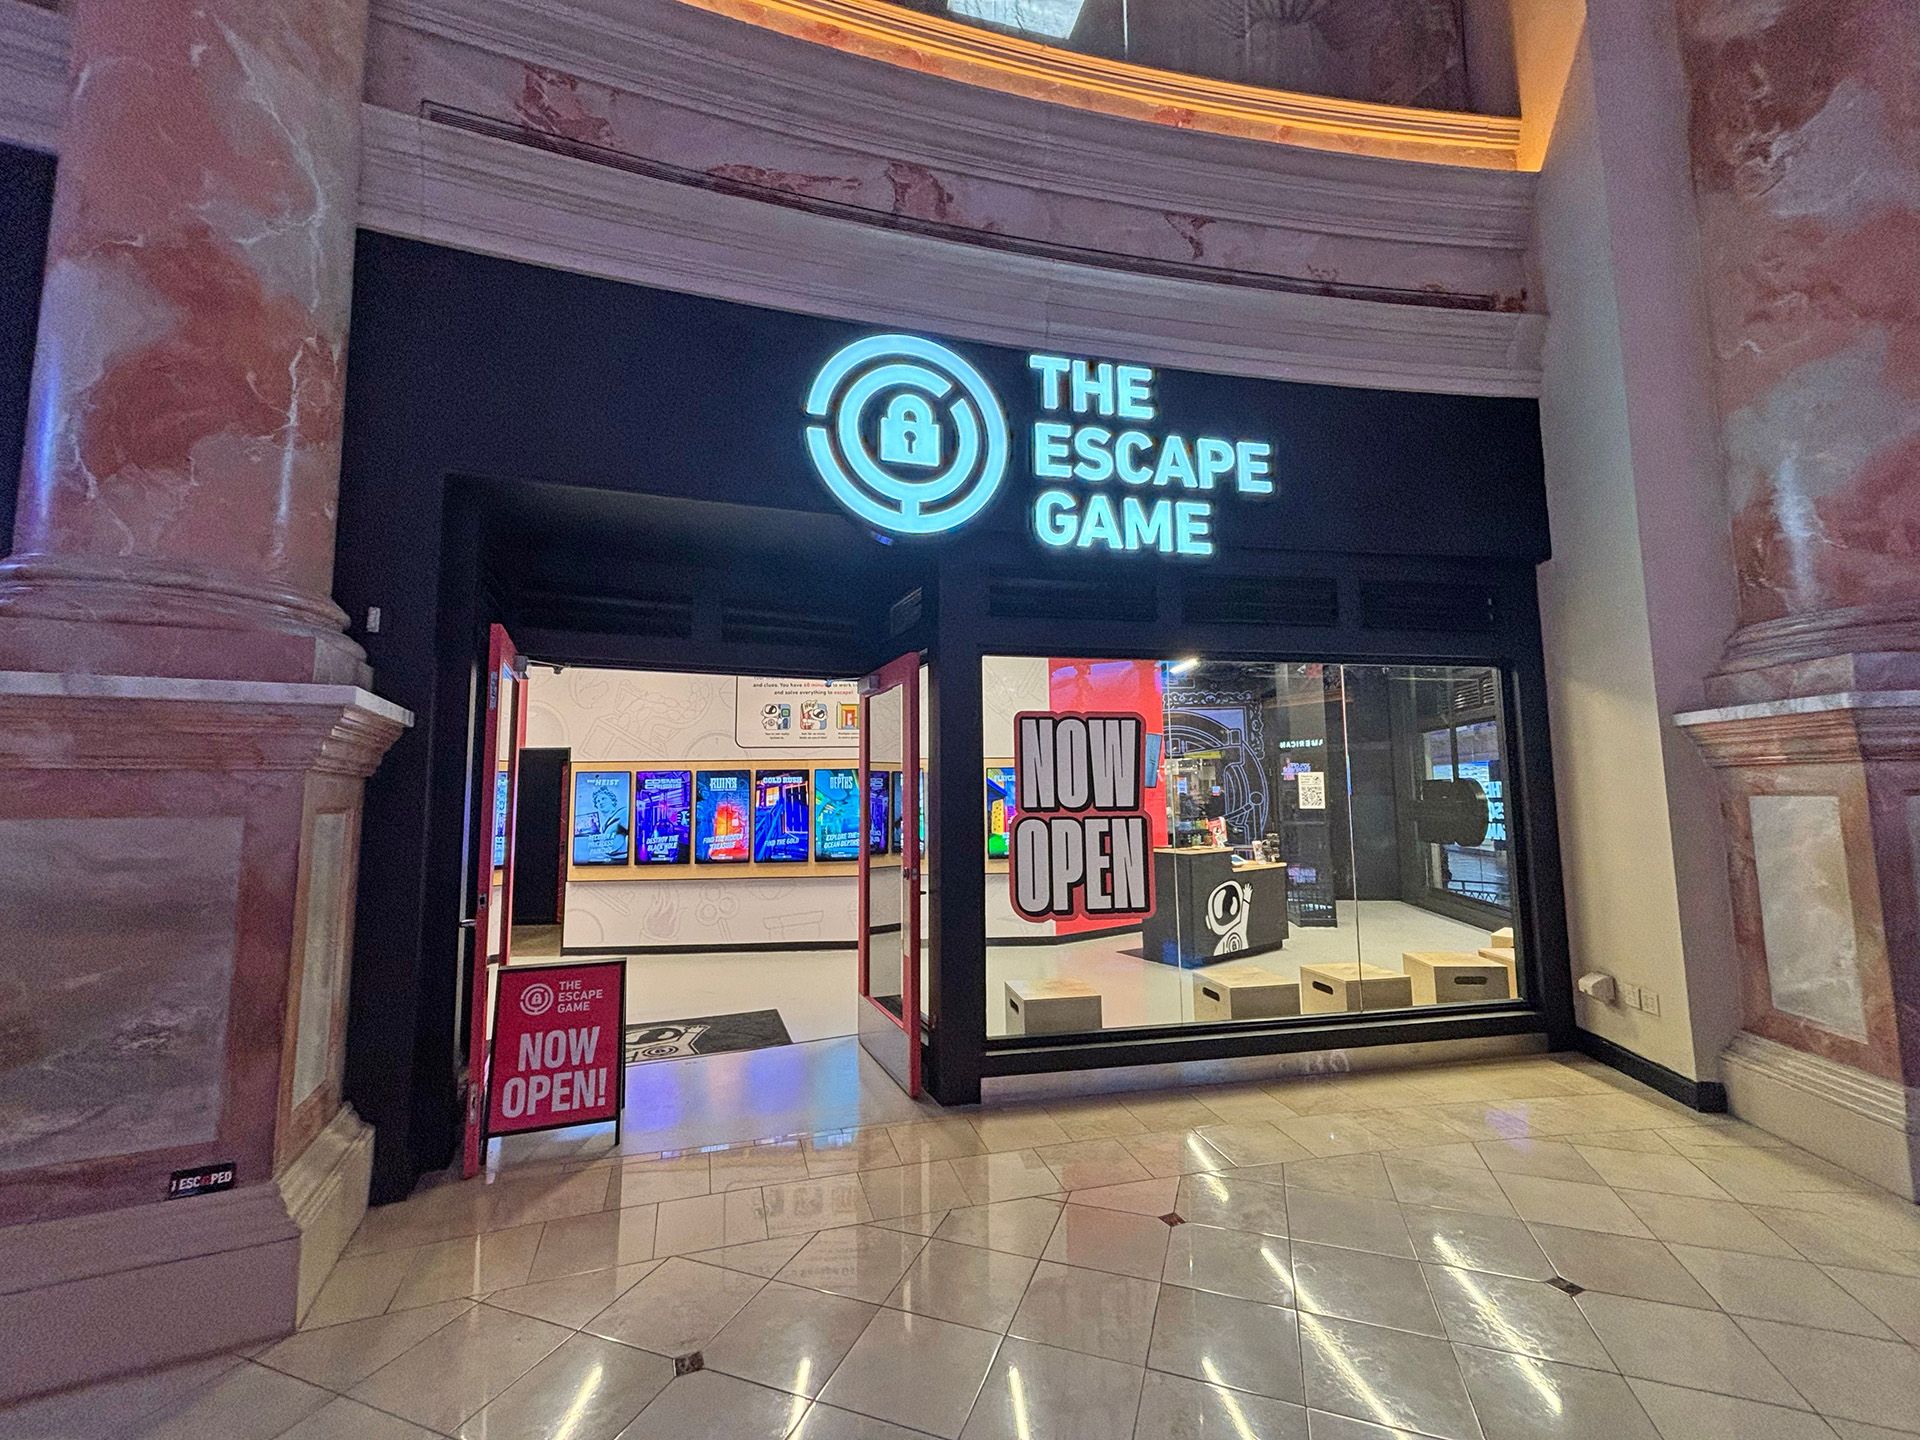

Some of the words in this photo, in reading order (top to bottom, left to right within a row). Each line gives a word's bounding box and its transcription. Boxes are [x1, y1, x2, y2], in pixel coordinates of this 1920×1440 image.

[1028, 354, 1156, 421] THE
[1032, 422, 1275, 495] ESCAPE
[1033, 490, 1215, 556] GAME
[1020, 717, 1140, 810] NOW
[709, 777, 738, 789] RUINS
[762, 776, 781, 784] GOLD
[830, 776, 854, 789] DEPTHS
[824, 840, 840, 849] OCEAN
[1016, 816, 1149, 914] OPEN
[558, 980, 582, 990] THE
[558, 989, 603, 1002] ESCAPE
[557, 1001, 590, 1014] GAME
[517, 1026, 601, 1072] NOW
[502, 1068, 608, 1119] OPEN!
[179, 1171, 233, 1190] ESCPED
